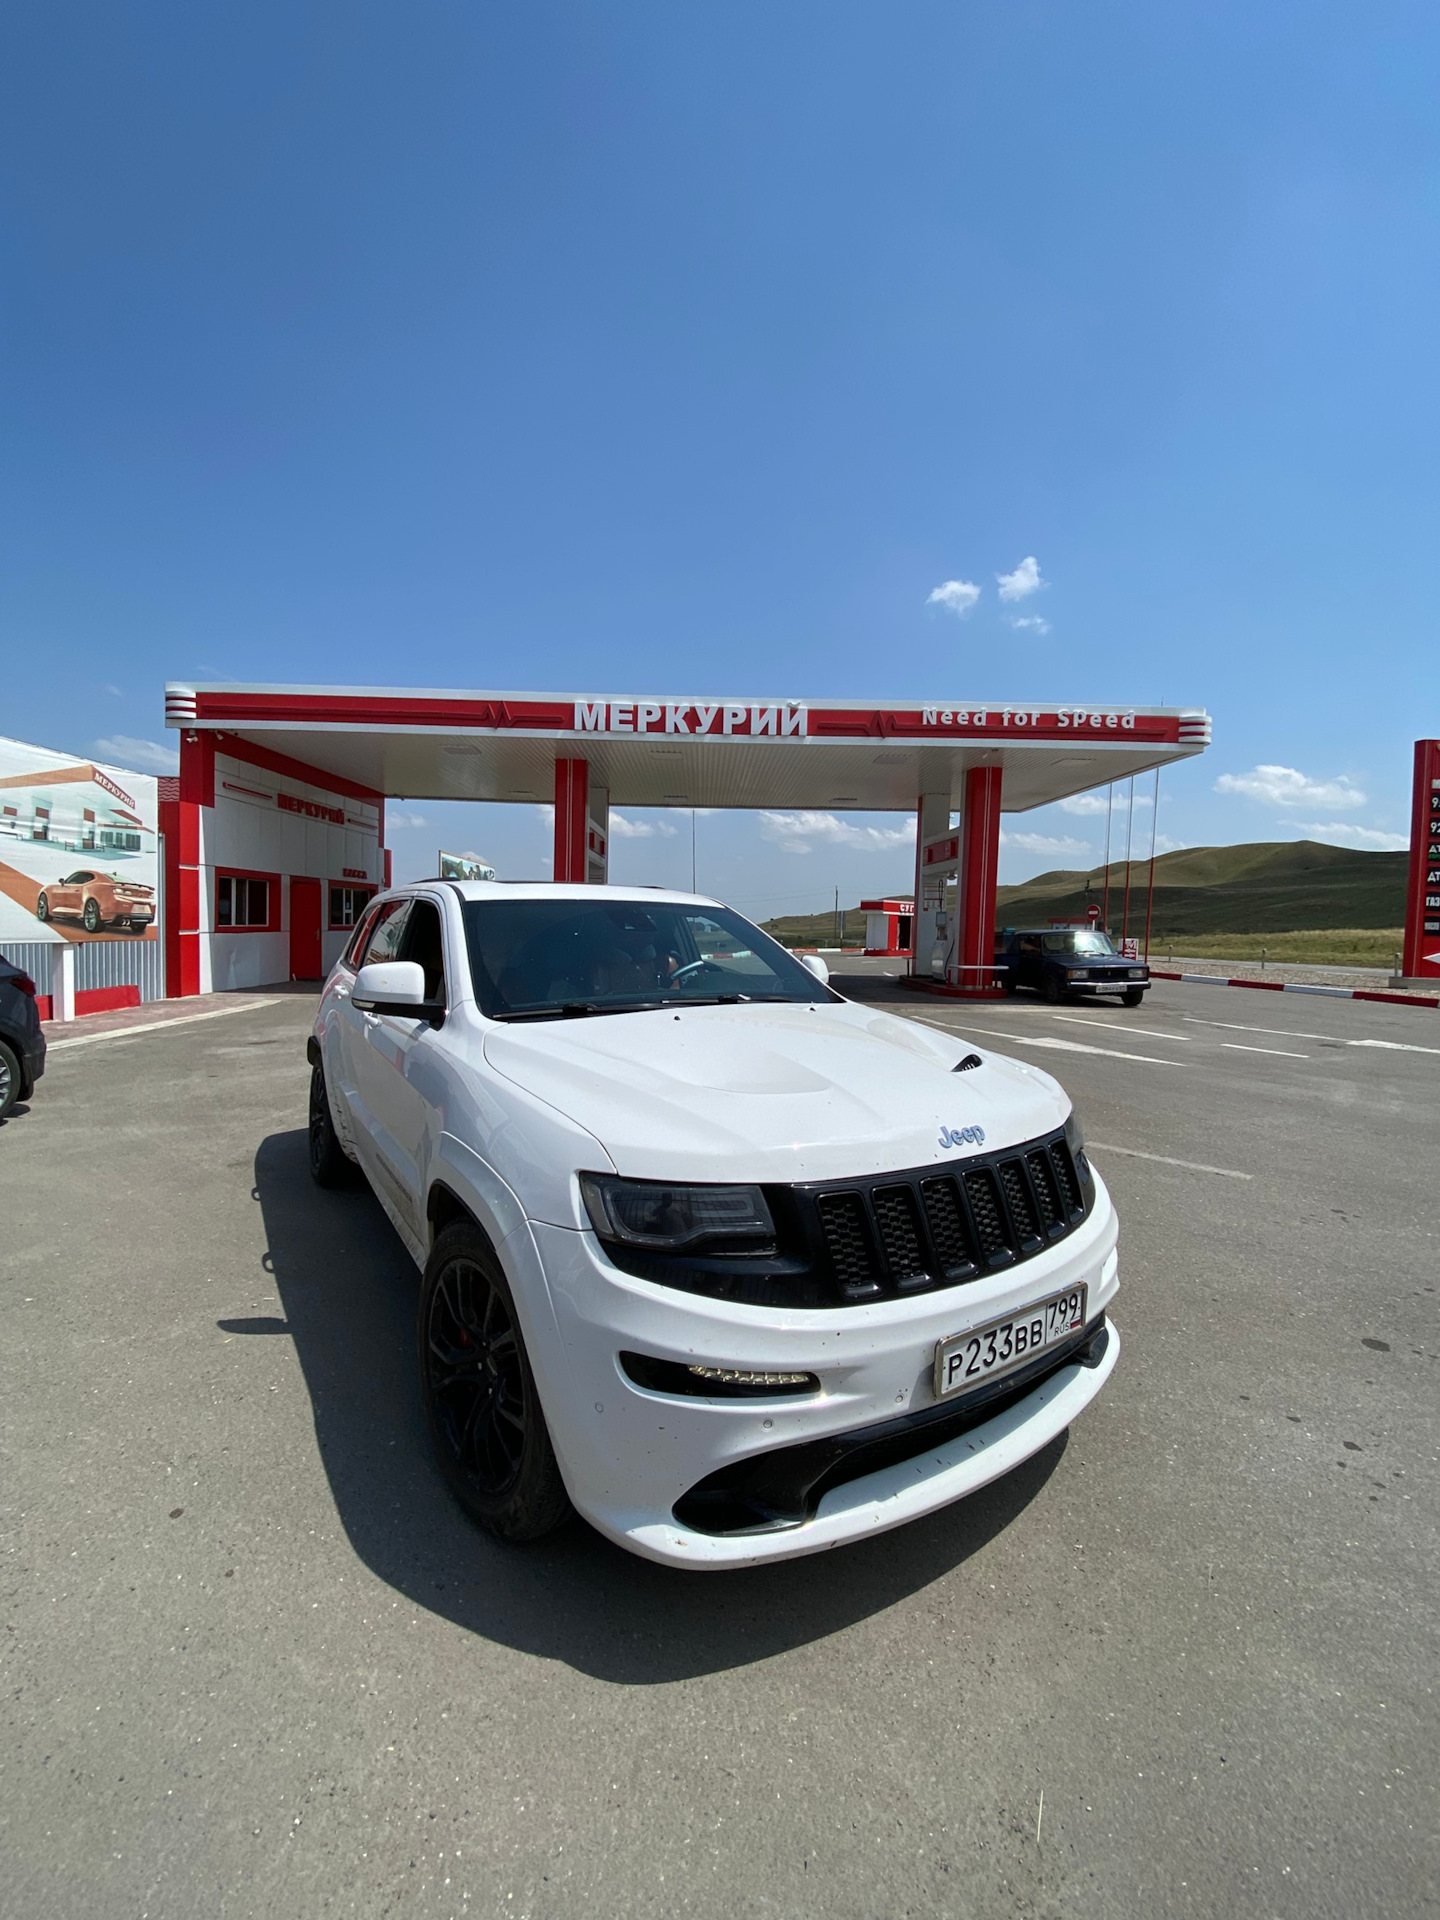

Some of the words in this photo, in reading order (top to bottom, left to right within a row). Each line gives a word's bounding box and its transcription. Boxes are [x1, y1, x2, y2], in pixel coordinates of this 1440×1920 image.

[574, 699, 808, 736] МЕРКУРИЙ
[921, 707, 987, 726] Need
[1002, 708, 1040, 726] for
[94, 772, 135, 808] МЕРКУРИЙ
[277, 793, 345, 825] МЕРКУРИЙ
[938, 1124, 985, 1148] Jeep
[1048, 1293, 1078, 1330] 799
[1053, 1322, 1070, 1337] RUS
